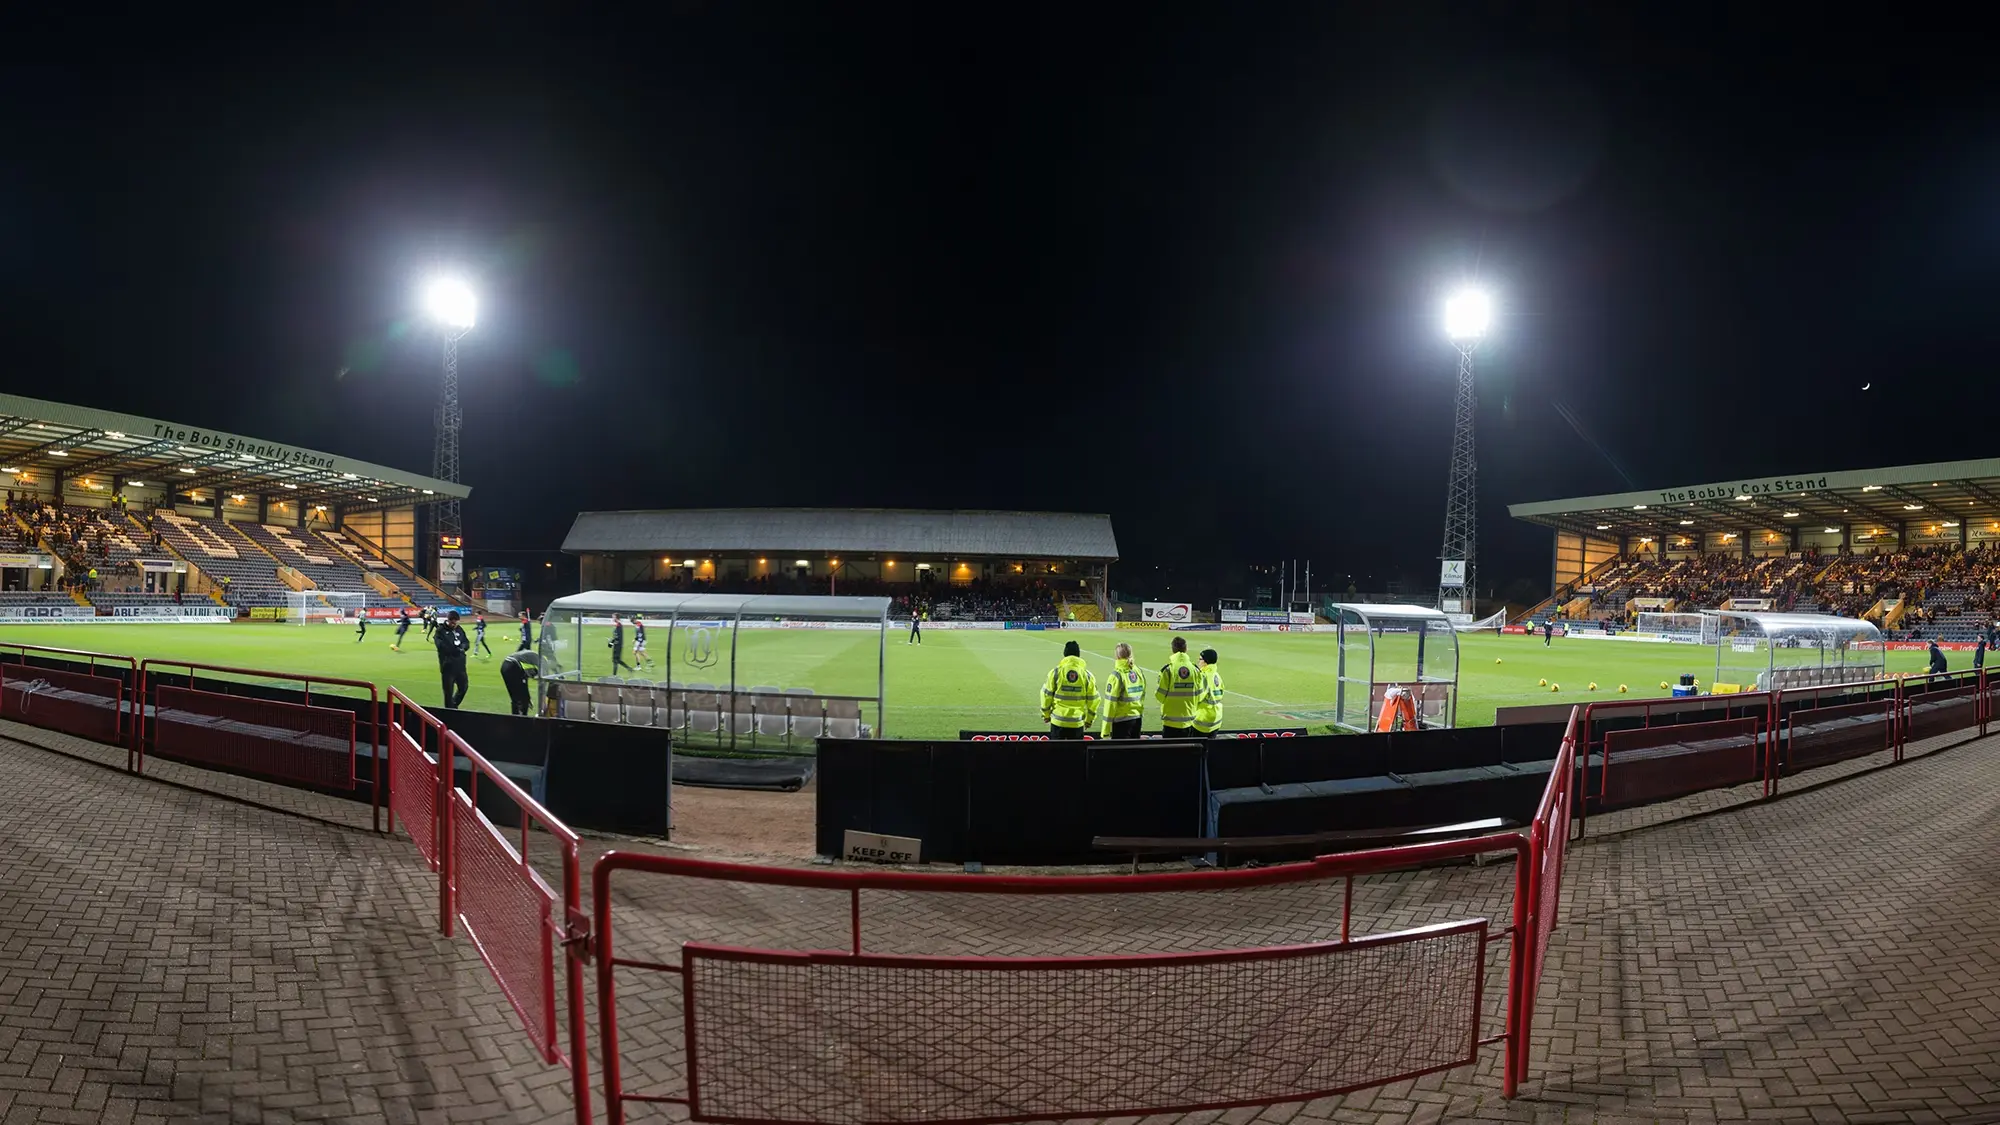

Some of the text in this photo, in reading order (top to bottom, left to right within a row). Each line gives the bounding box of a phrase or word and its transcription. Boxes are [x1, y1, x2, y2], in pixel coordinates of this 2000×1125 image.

[153, 424, 335, 469] The Bob Shankly Stand
[1660, 477, 1828, 503] The Bobby Cox Stand
[114, 607, 140, 617] ABLE
[1221, 624, 1246, 632] swinton
[1278, 624, 1290, 632] GT
[1732, 644, 1755, 652] HOME
[1893, 643, 1922, 651] Ladbrokes
[852, 846, 885, 857] KEEP
[890, 851, 912, 861] OFF
